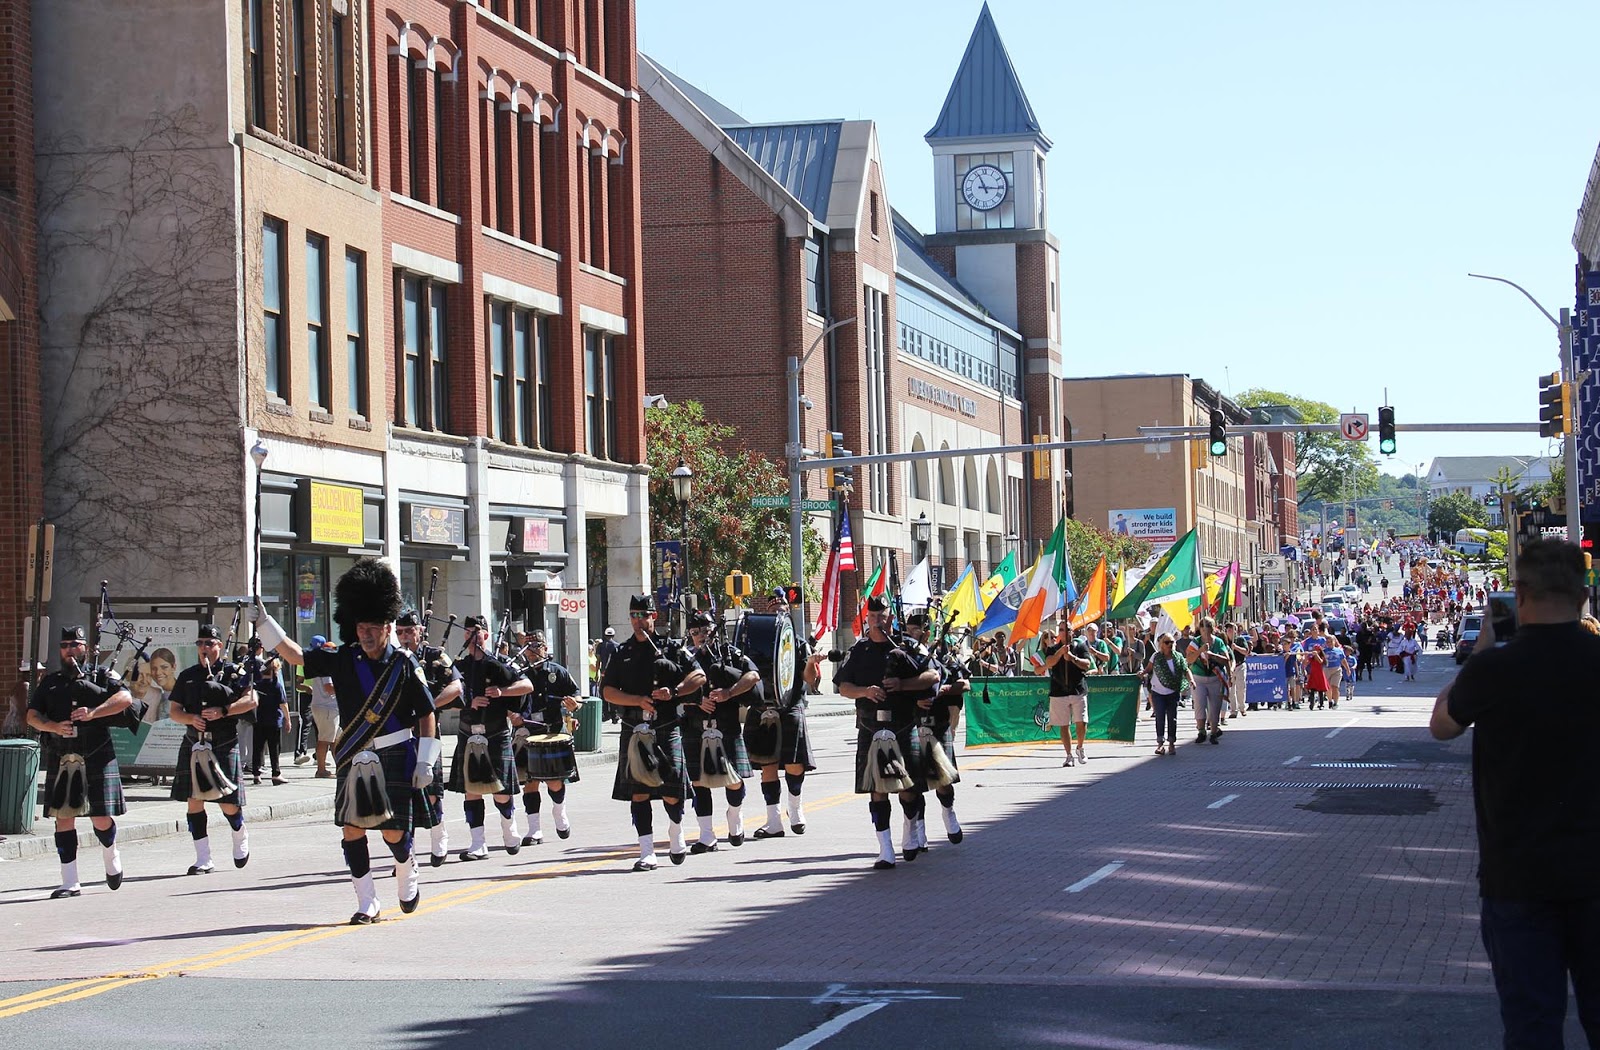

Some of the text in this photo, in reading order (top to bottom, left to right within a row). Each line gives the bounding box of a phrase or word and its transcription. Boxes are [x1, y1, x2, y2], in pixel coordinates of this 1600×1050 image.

[317, 486, 342, 511] GOLDEN
[342, 490, 356, 513] WOK
[752, 498, 784, 506] PHOENIX
[802, 501, 831, 509] BROOK
